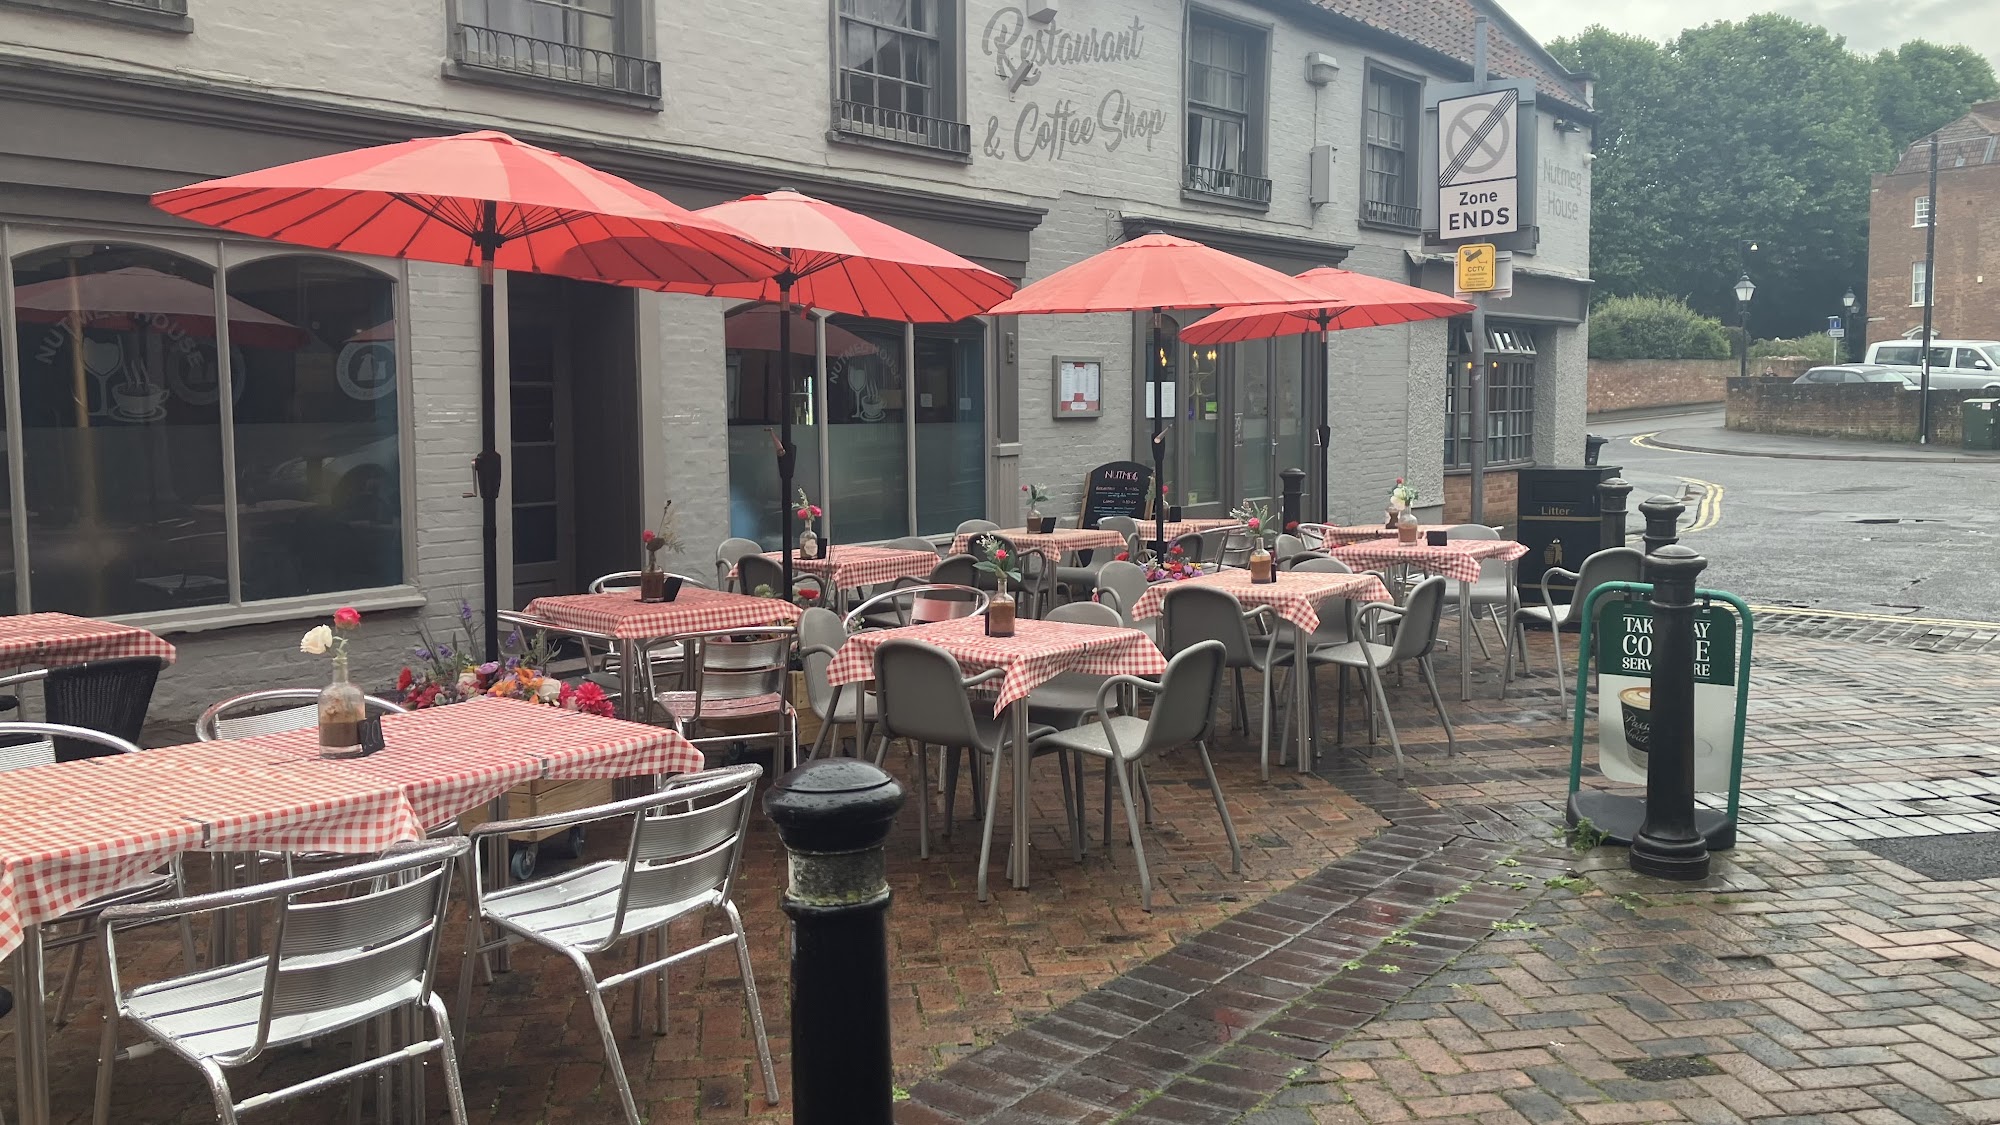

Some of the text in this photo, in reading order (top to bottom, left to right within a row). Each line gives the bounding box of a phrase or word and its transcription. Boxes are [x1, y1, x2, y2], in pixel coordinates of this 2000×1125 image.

[981, 6, 1144, 86] Restaurant
[983, 89, 1167, 162] & Coffee Shop
[1543, 157, 1582, 196] Nutmeg
[1459, 191, 1498, 206] Zone
[1547, 189, 1579, 220] House
[1449, 207, 1510, 231] ENDS
[829, 343, 903, 385] NUTMEG HOUSE
[1541, 506, 1570, 516] Litter
[1622, 634, 1711, 662] COE
